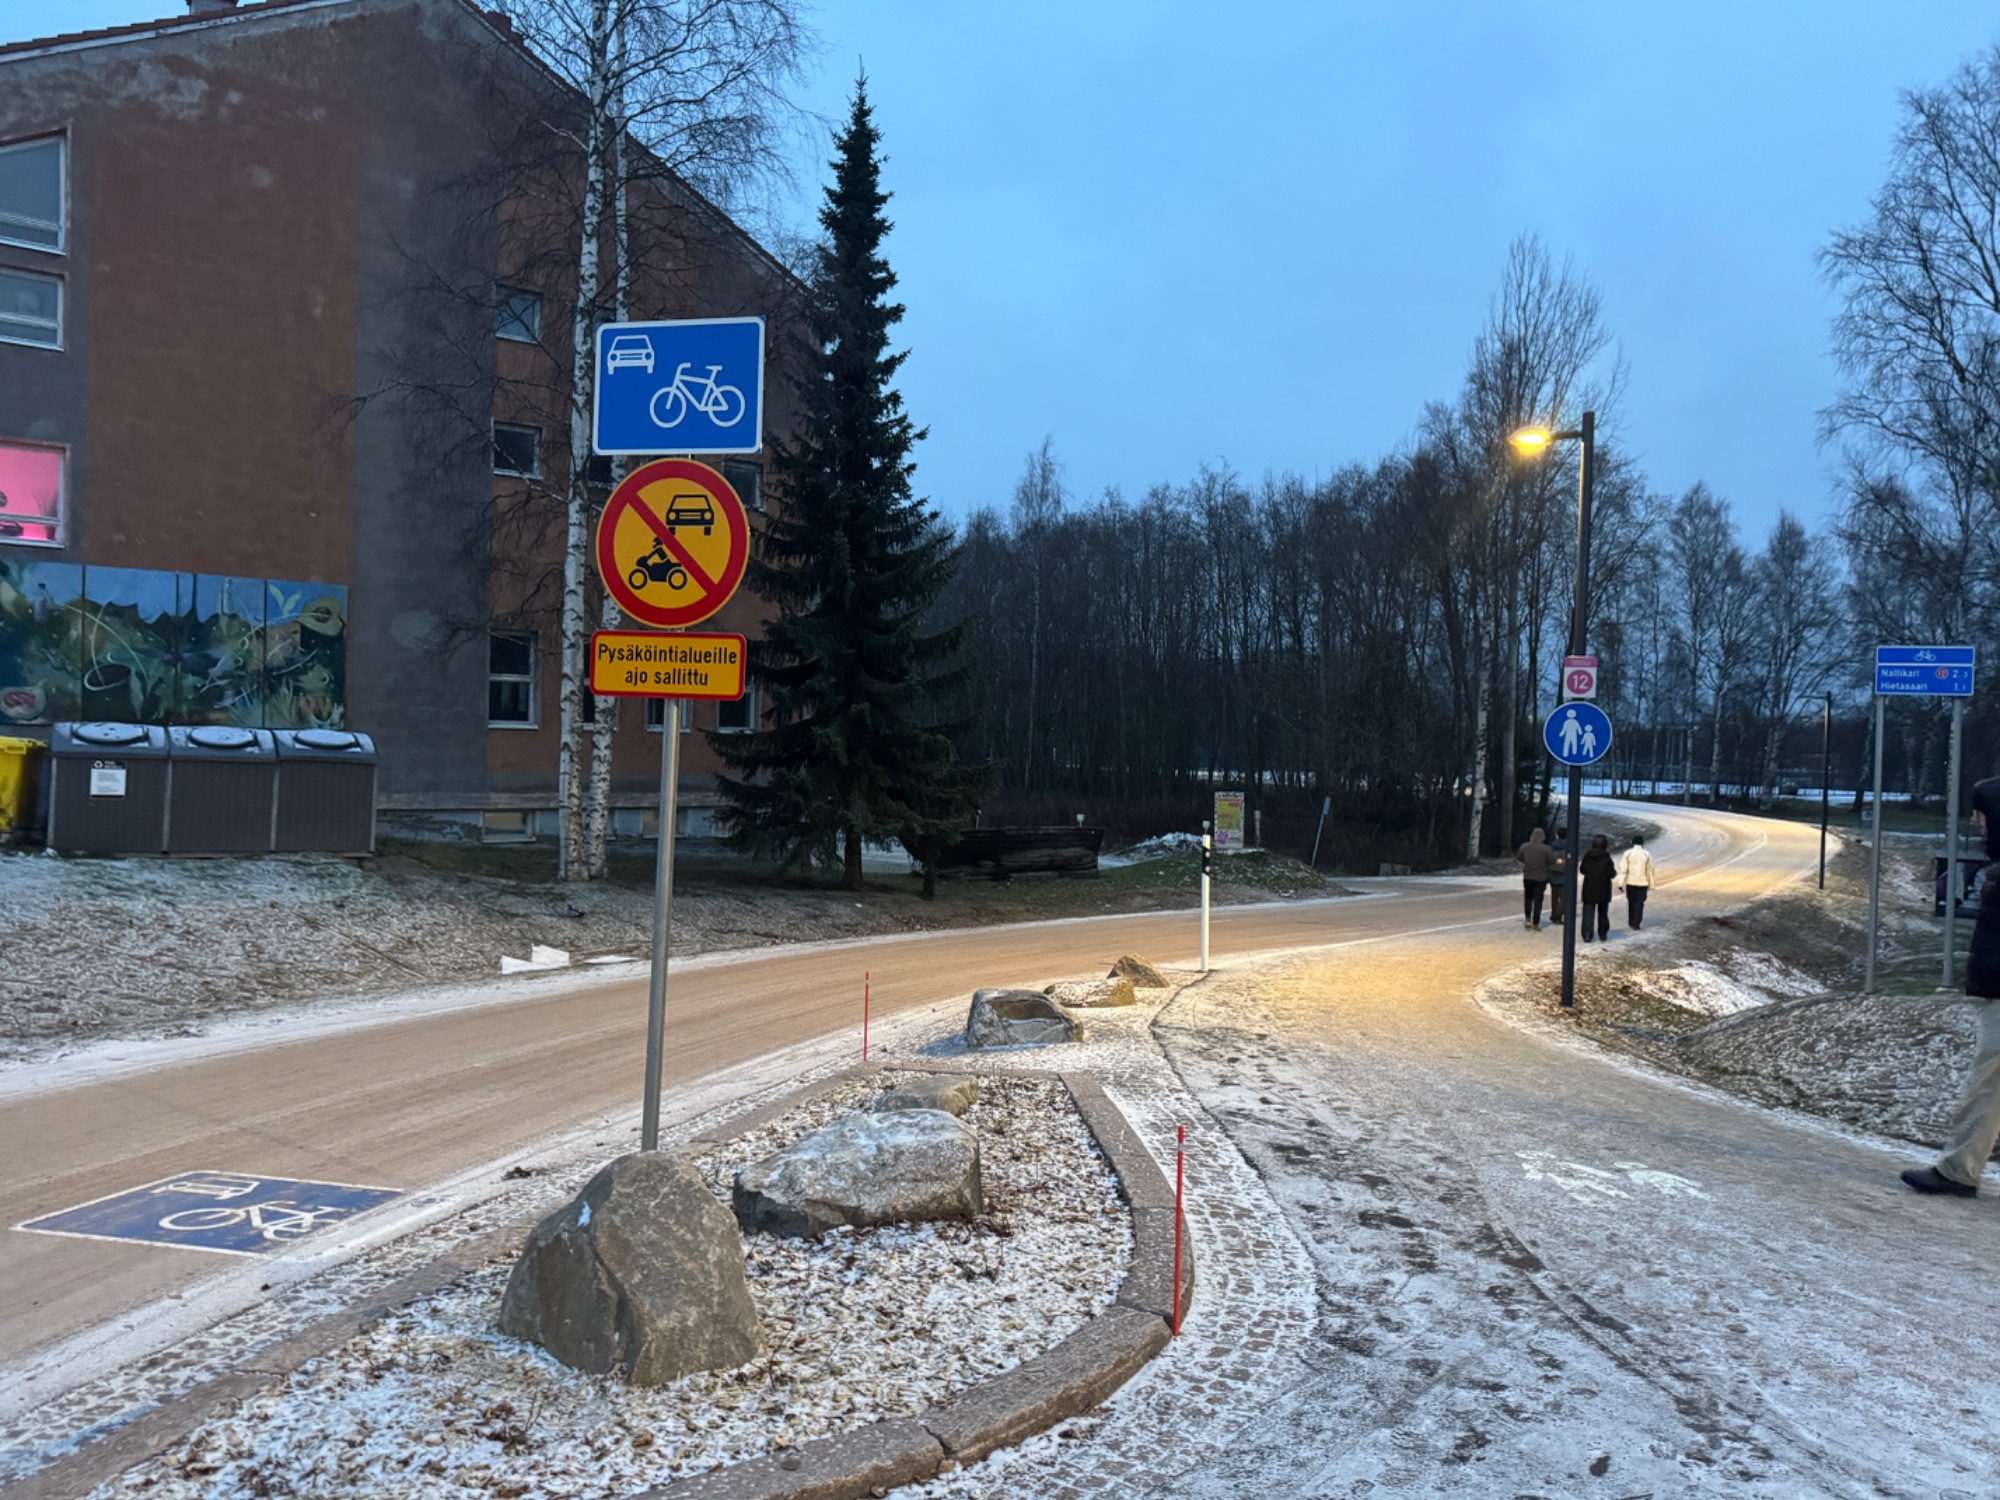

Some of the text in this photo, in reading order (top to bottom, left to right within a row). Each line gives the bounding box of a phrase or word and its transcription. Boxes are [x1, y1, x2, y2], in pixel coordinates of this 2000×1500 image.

[598, 643, 737, 664] Pysäköintialueille
[625, 667, 708, 686] ajo sallittu
[1881, 668, 1920, 677] Nallikari
[1572, 674, 1589, 689] 12
[1880, 682, 1928, 690] Hietasaari
